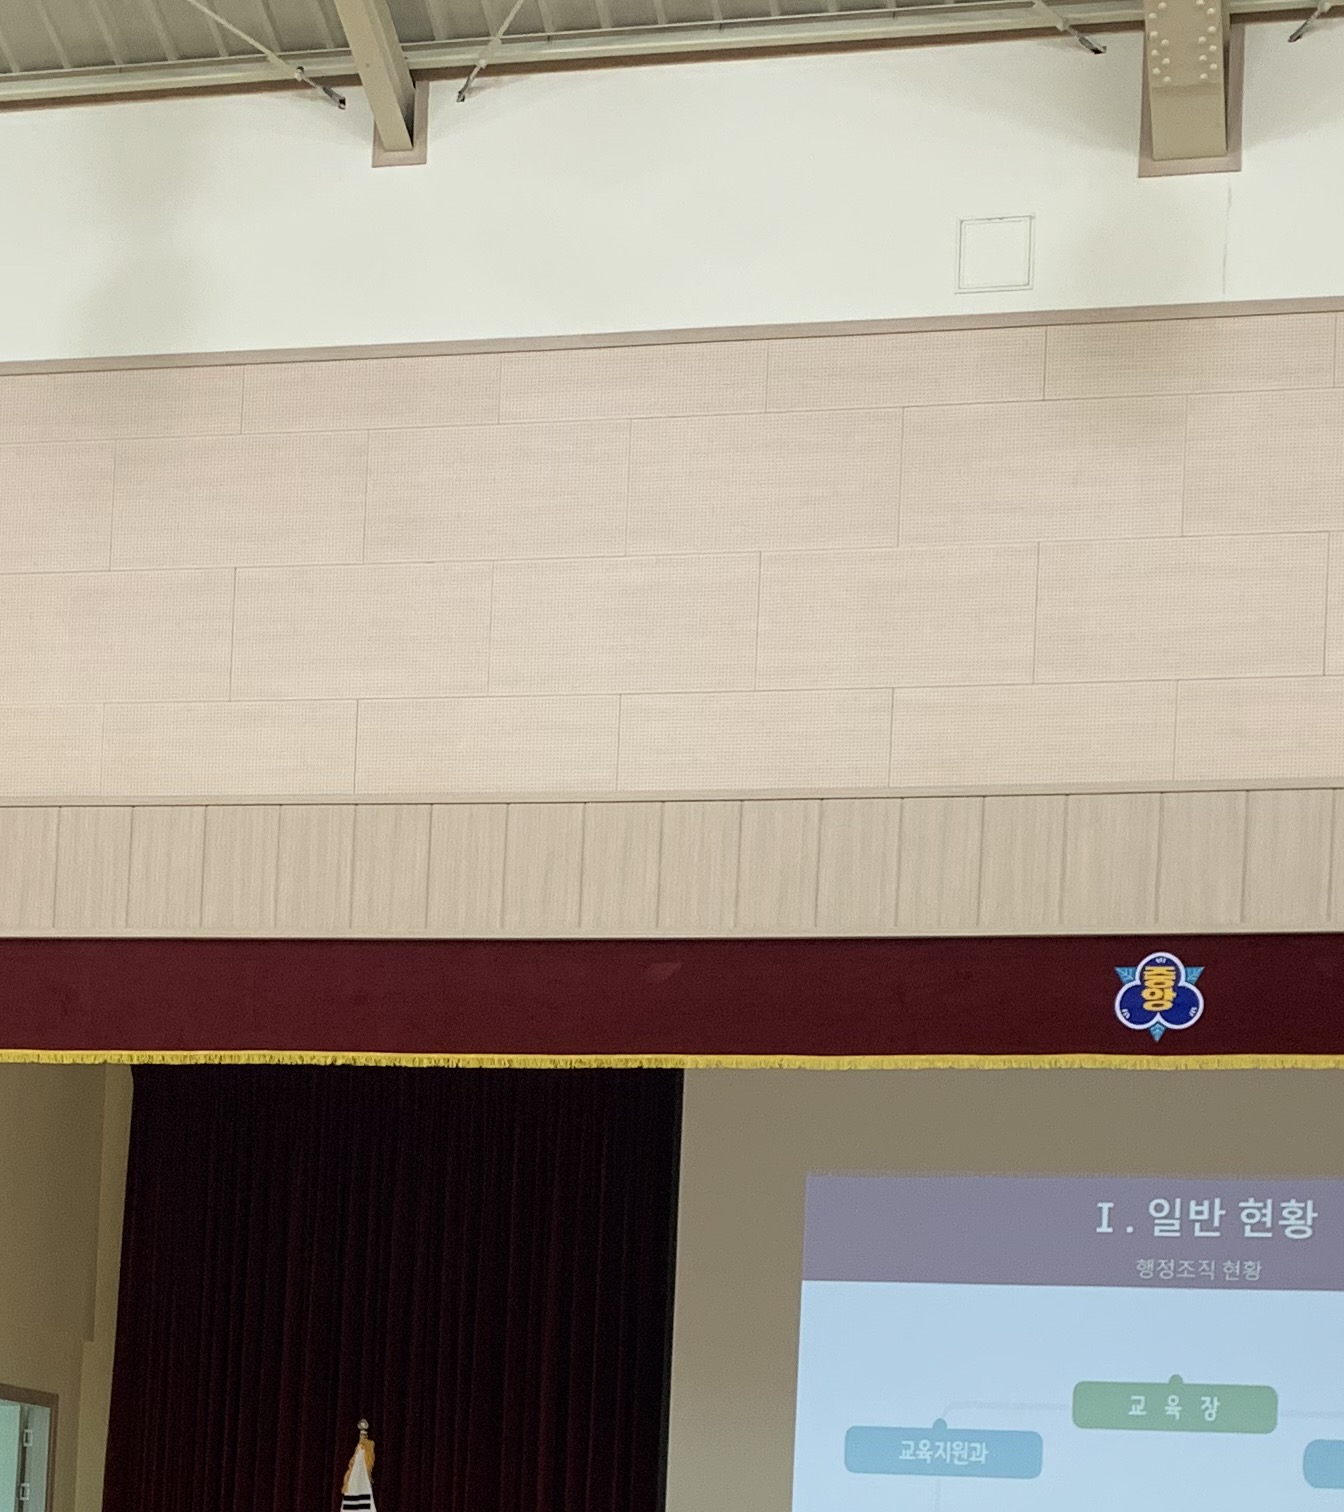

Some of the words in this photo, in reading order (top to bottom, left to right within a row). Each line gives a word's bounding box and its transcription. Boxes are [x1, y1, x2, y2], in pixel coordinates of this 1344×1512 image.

[1148, 1198, 1227, 1237] 일반
[1238, 1197, 1318, 1239] 현황
[1136, 1259, 1216, 1280] 행정조직
[1222, 1260, 1262, 1281] 현황
[899, 1439, 988, 1465] 교육지원과
